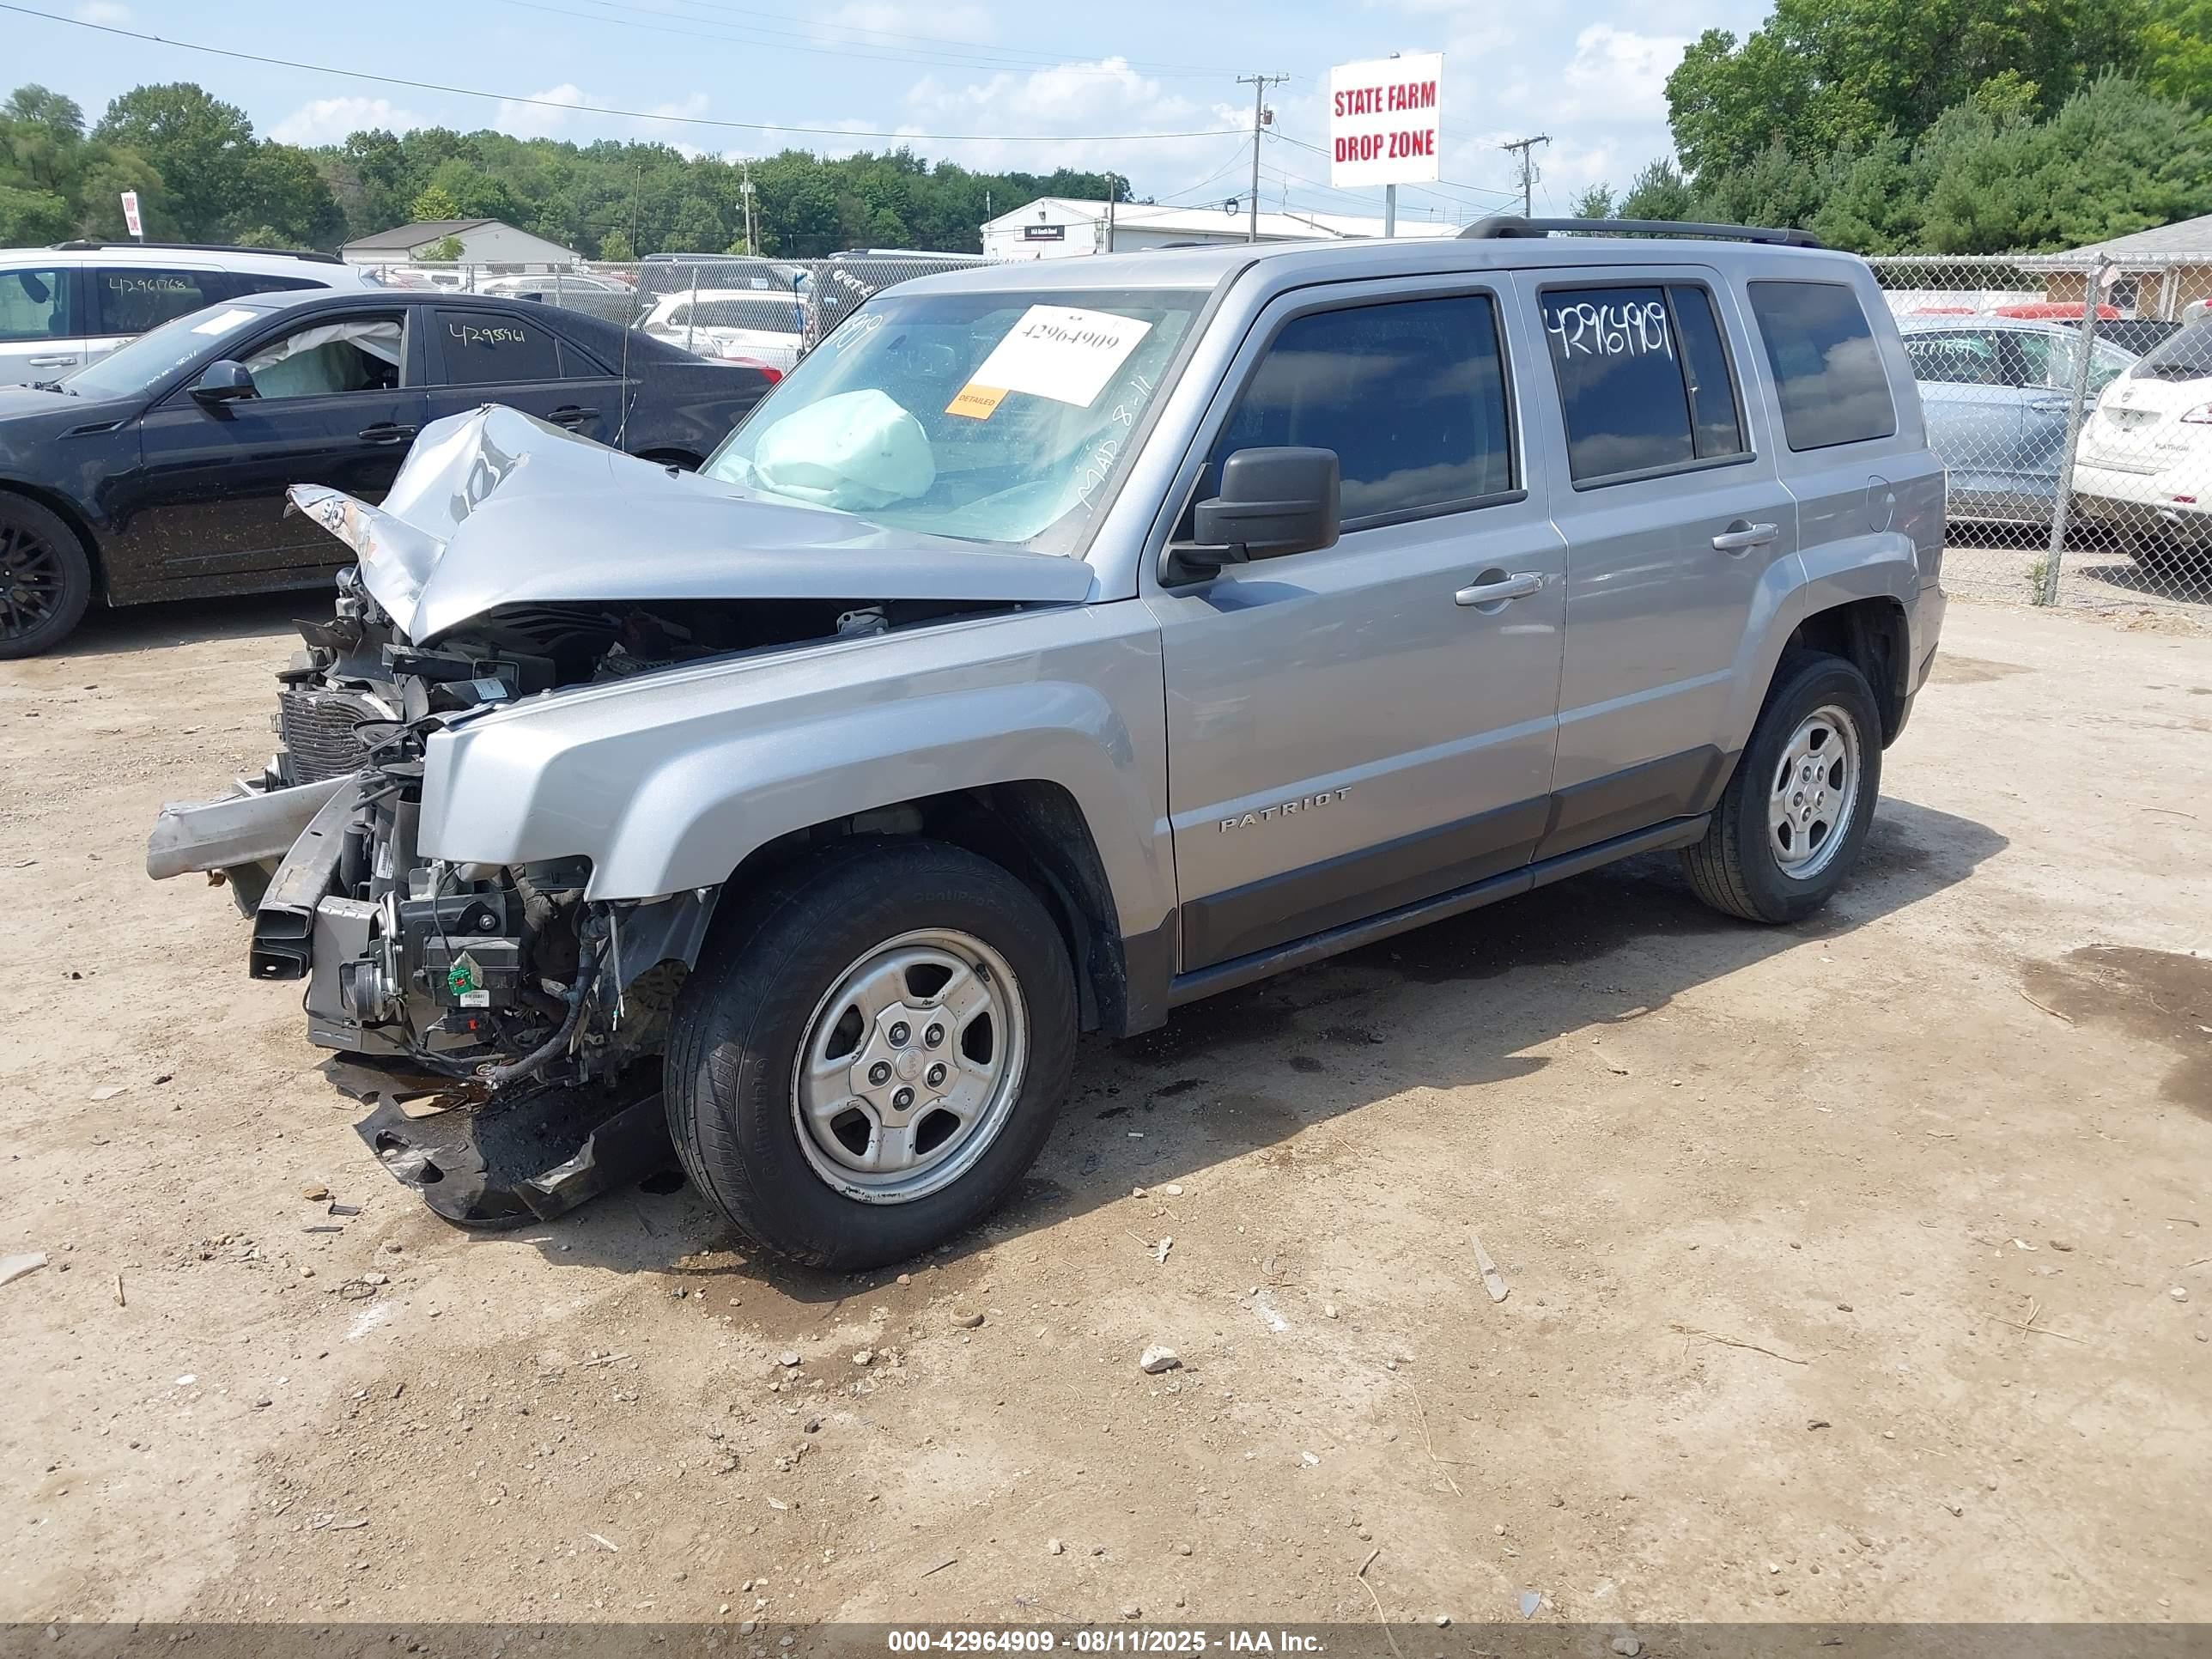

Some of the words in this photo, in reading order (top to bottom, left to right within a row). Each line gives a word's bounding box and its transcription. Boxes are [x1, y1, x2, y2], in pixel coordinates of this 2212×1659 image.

[1334, 86, 1383, 117] STATE
[1388, 80, 1437, 112] FARM
[1335, 133, 1384, 163] DROP
[1389, 129, 1435, 159] ZONE
[109, 277, 186, 296] 42961768
[1022, 324, 1120, 350] 42964909
[1543, 301, 1673, 362] 42964909
[958, 393, 996, 407] DETAILED
[1077, 439, 1118, 510] MAD
[1218, 786, 1352, 834] PATRIOT
